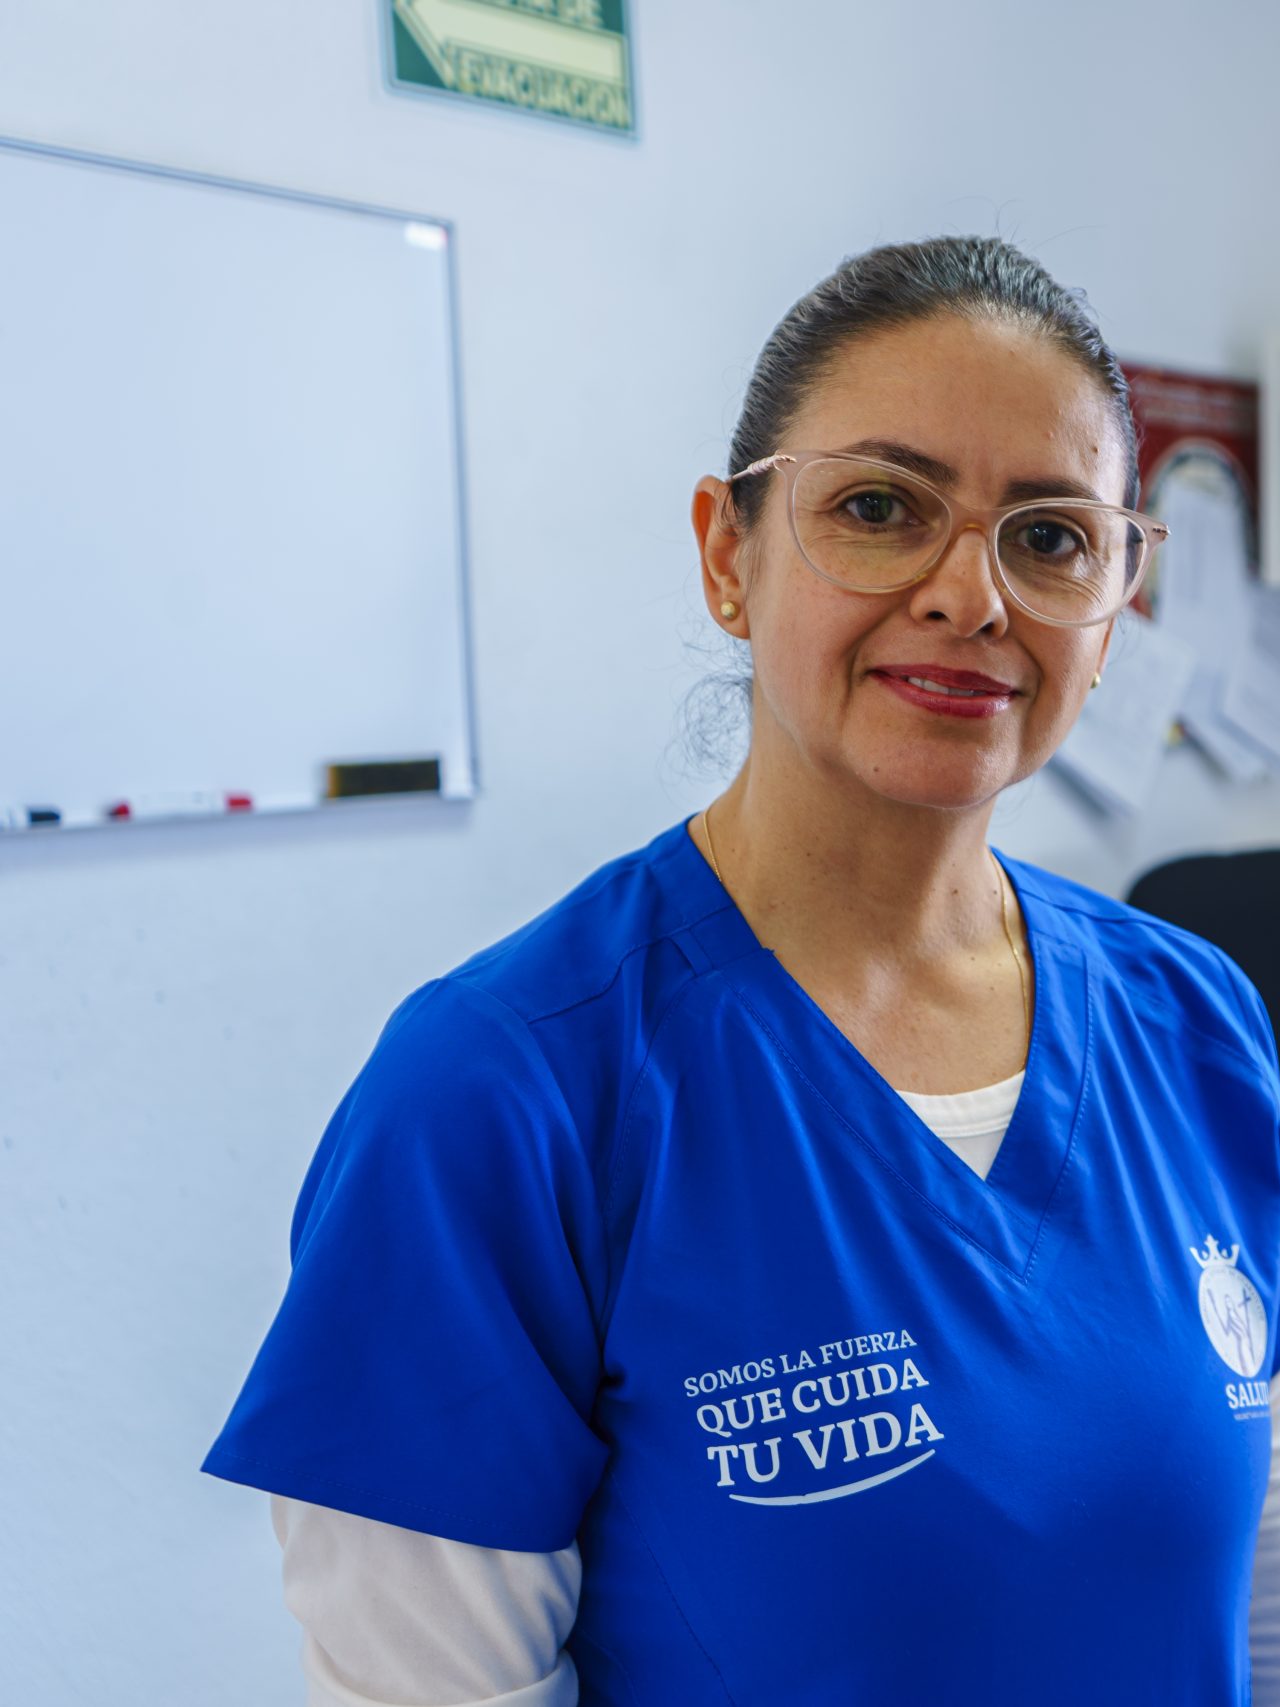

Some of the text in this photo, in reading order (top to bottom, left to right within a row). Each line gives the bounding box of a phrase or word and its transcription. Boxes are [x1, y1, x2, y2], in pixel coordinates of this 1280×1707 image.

[684, 1329, 918, 1398] SOMOS LA FUERZA
[696, 1358, 929, 1438] QUE CUIDA
[706, 1403, 945, 1486] TU VIDA
